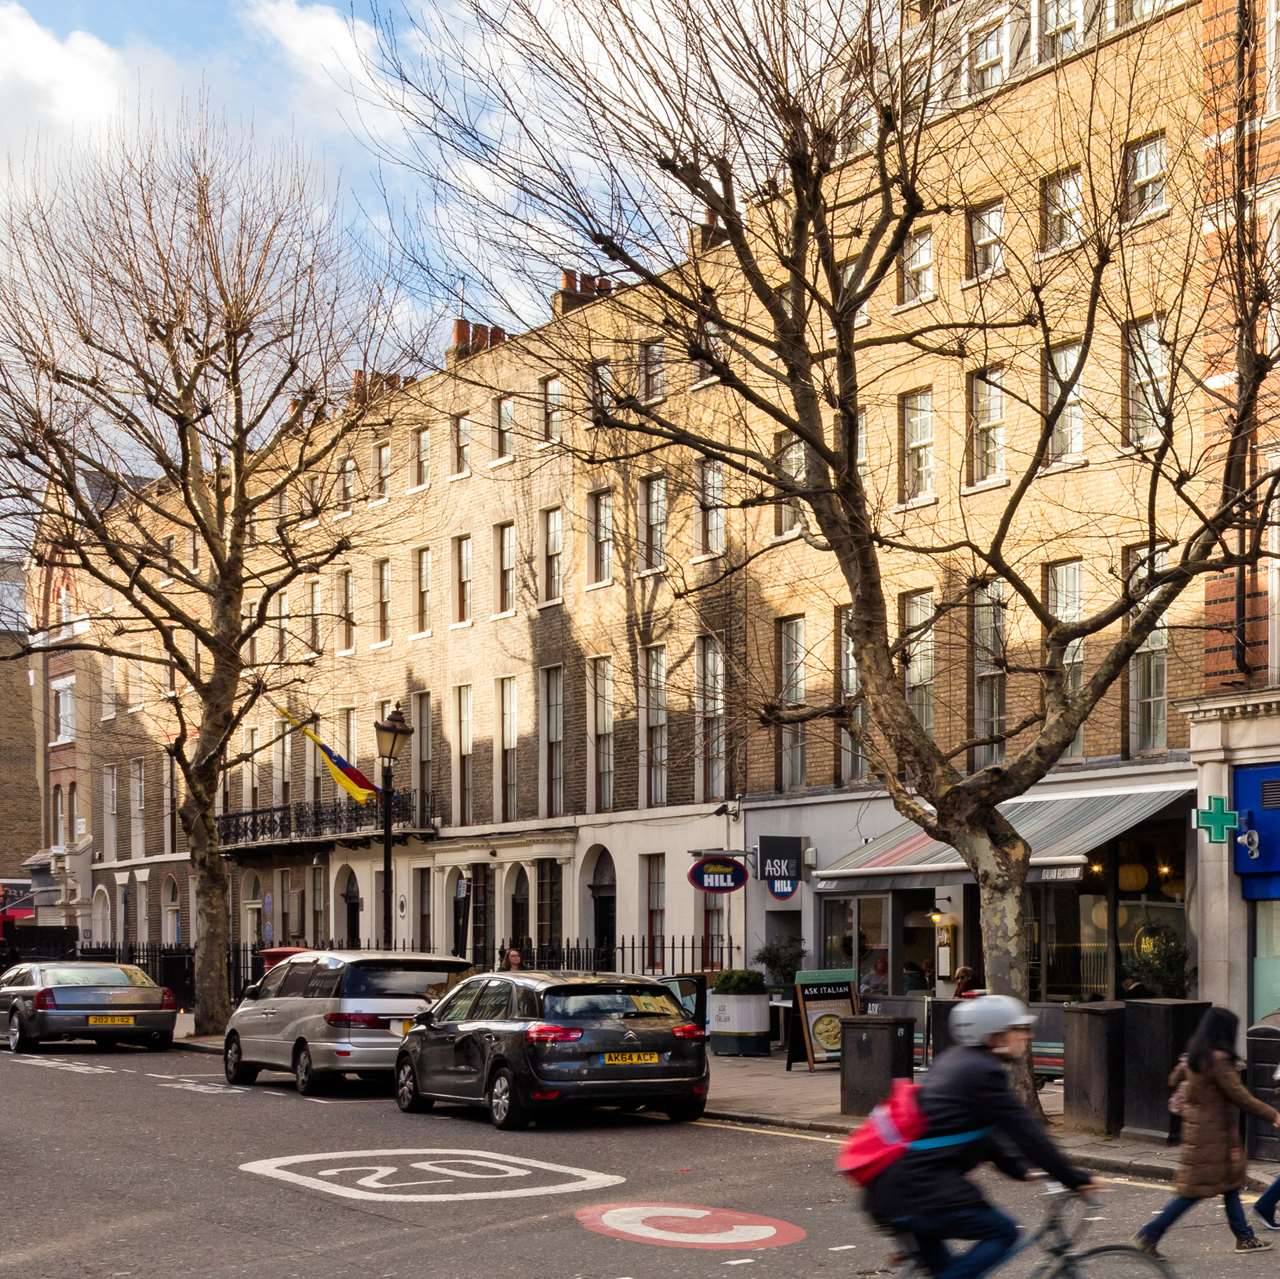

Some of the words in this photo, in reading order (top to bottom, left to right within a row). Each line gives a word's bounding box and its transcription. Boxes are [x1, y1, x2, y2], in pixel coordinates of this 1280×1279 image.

[764, 859, 788, 876] ASK
[704, 874, 734, 886] HILL
[774, 880, 792, 892] HILL
[804, 987, 818, 996] ASK
[820, 986, 848, 994] ITALIAN
[318, 1159, 532, 1188] 20
